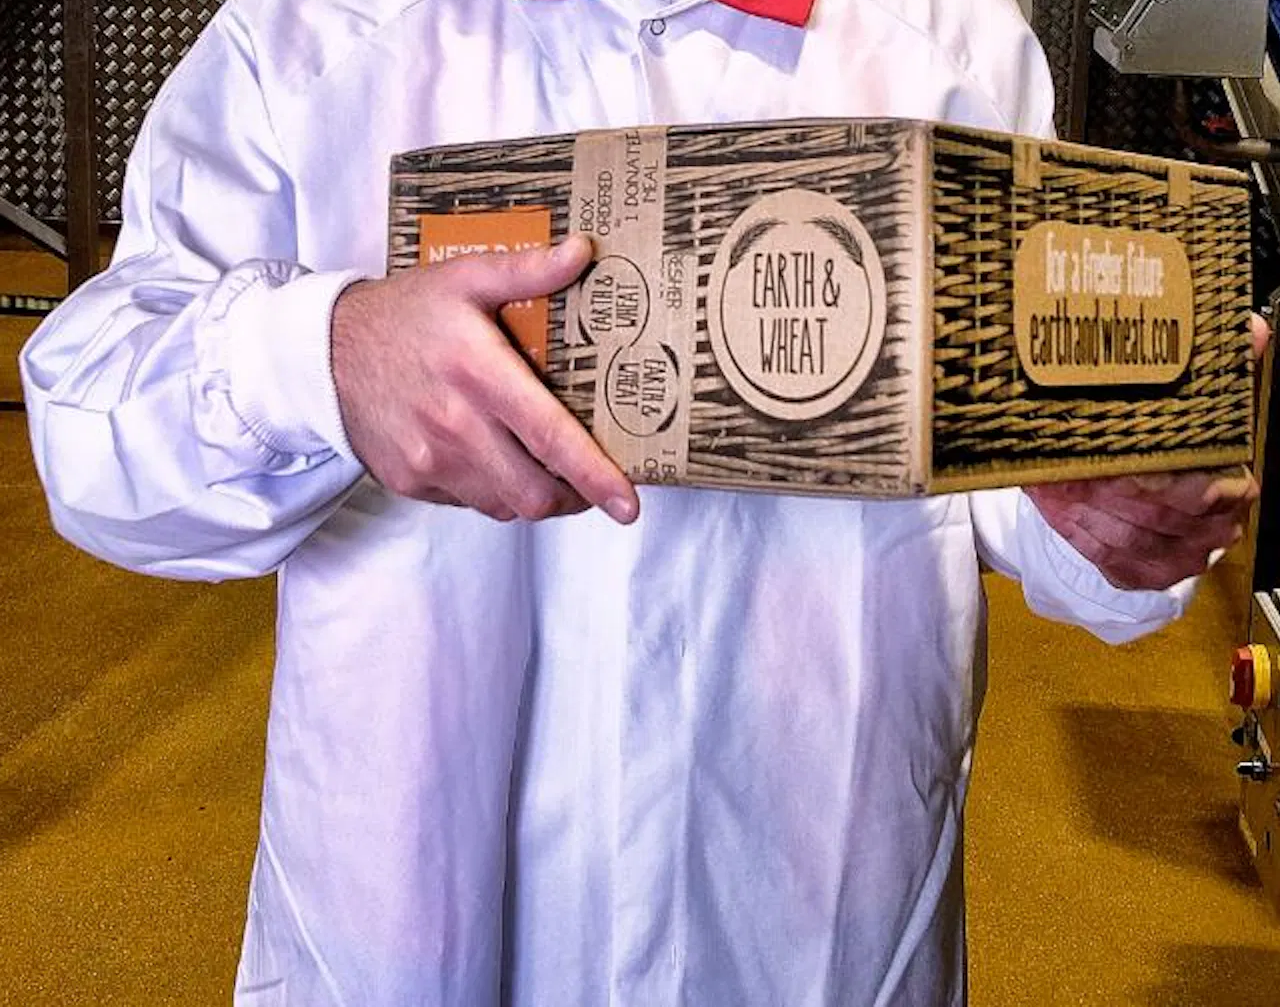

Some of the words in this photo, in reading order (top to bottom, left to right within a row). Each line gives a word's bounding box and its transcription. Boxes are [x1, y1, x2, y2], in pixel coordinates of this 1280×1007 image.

[597, 170, 613, 236] ORDERED
[642, 159, 658, 203] MEAL
[580, 197, 595, 232] BOX
[594, 274, 613, 287] &
[752, 251, 816, 309] EARTH
[821, 258, 841, 309] &
[1045, 230, 1068, 295] for
[589, 290, 613, 332] EARTH
[615, 283, 639, 328] WHEAT
[759, 317, 829, 375] WHEAT
[1029, 297, 1180, 367] earthandwheat.com
[614, 362, 640, 408] WHEAT
[642, 358, 667, 401] EARTH
[641, 404, 662, 417] &
